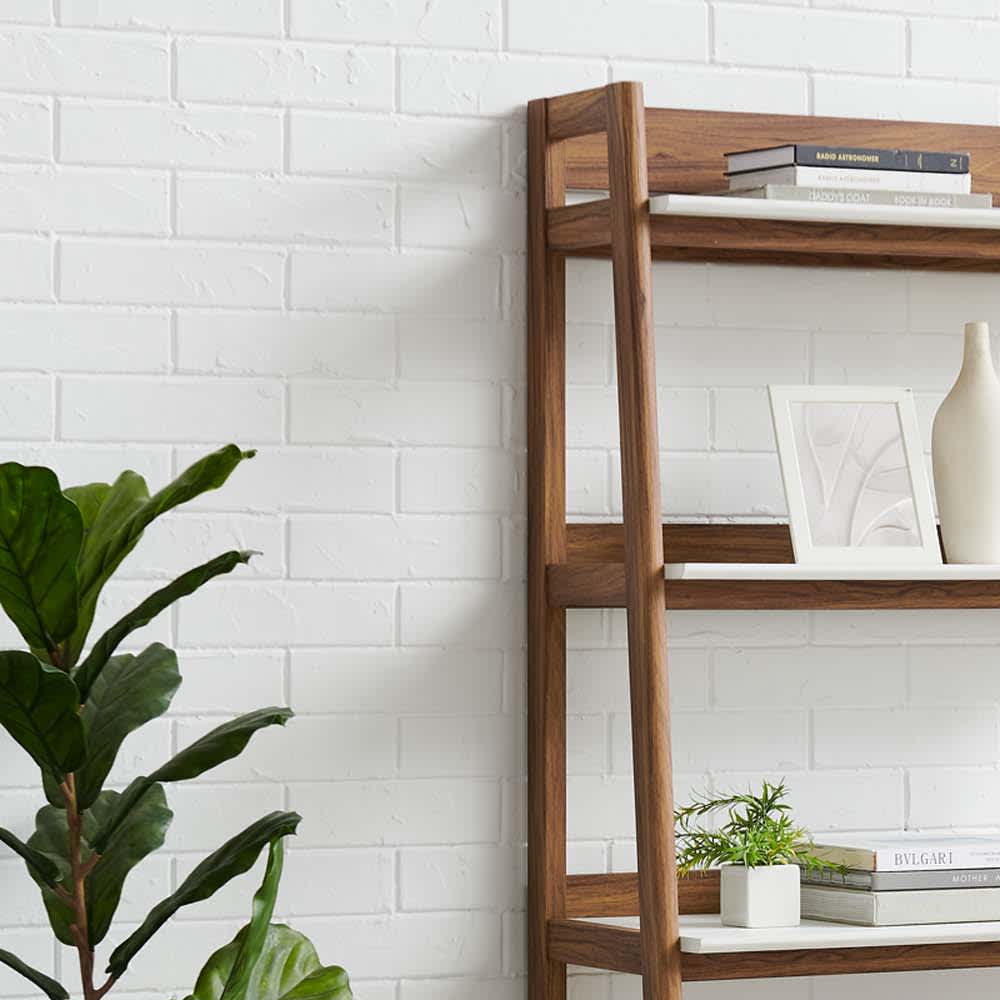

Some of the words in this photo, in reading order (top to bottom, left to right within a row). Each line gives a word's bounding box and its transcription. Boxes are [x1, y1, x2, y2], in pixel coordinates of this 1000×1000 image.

[815, 151, 837, 161] RADIO
[894, 851, 953, 866] BVLGARI
[952, 873, 988, 883] MOTHER
